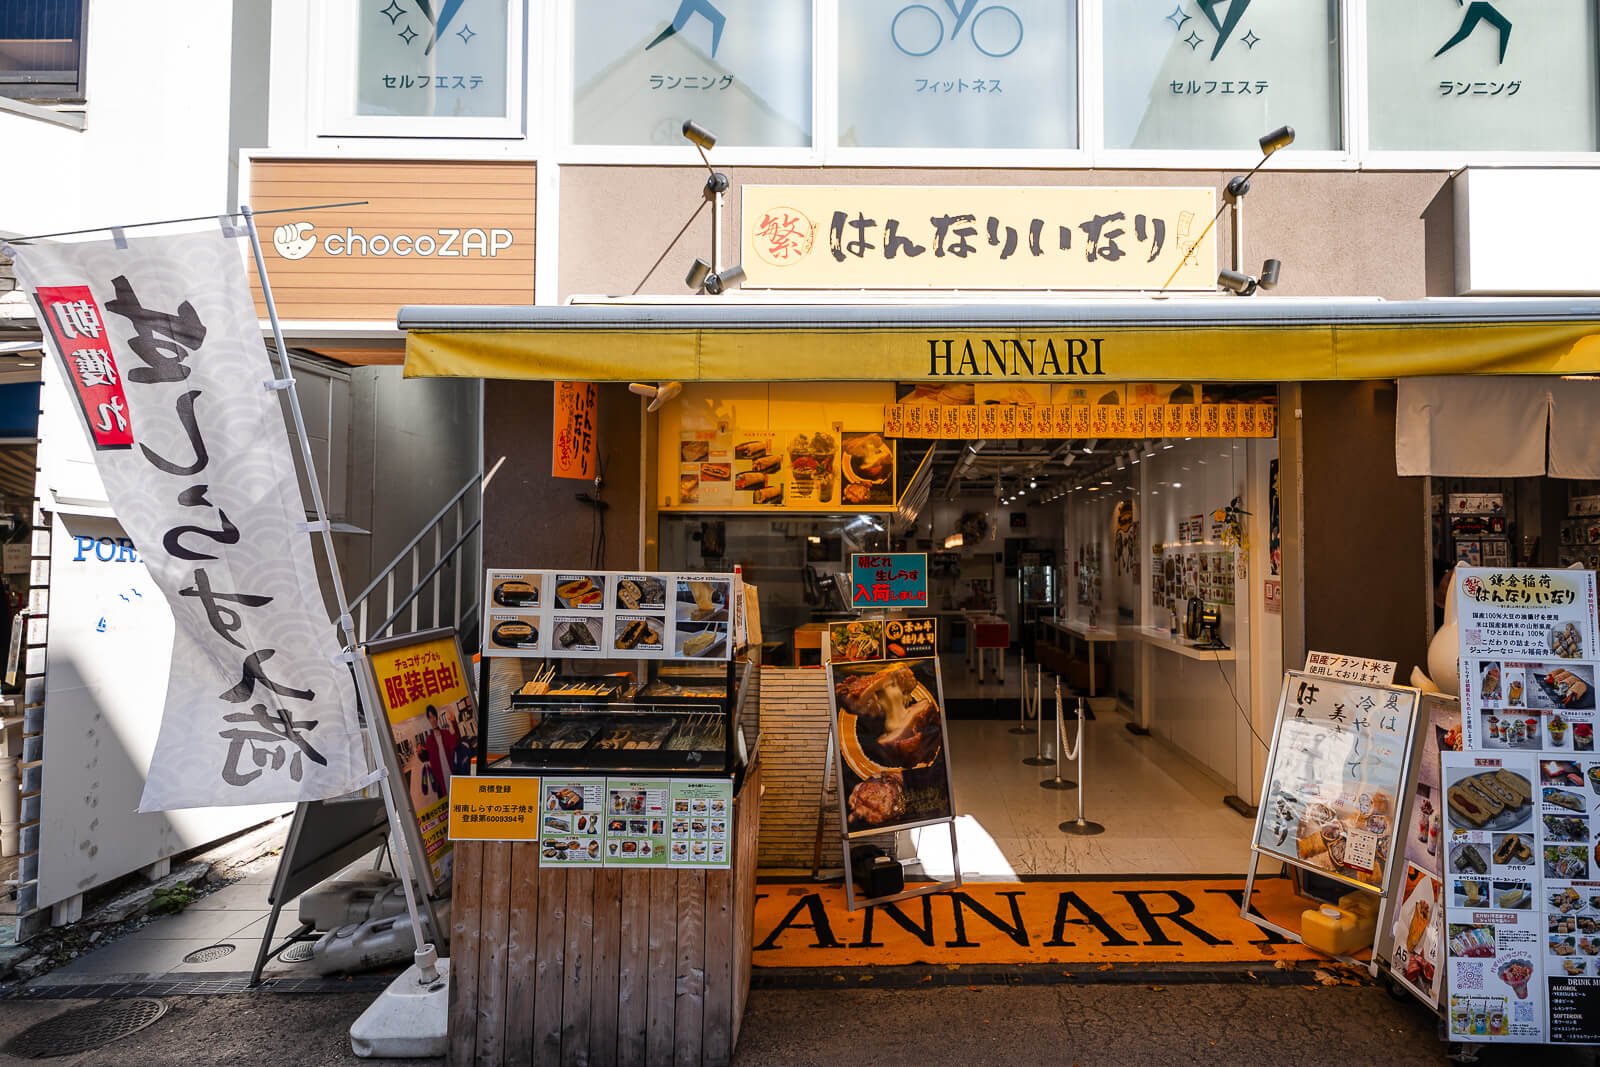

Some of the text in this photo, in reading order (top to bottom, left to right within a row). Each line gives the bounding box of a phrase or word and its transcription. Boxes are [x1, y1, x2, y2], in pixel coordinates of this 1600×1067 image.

[382, 74, 484, 91] セルフエステ
[649, 74, 734, 91] ランニング
[915, 78, 1003, 94] フィットネス
[1169, 79, 1269, 95] セルフエステ
[1439, 80, 1522, 97] ランニング
[323, 228, 514, 259] chocoZAP
[830, 211, 1166, 264] はんなりいなり
[927, 338, 1107, 376] HANNARI
[73, 535, 144, 562] POR
[875, 569, 920, 581] 生しらす
[1489, 574, 1551, 588] 鎌倉稲荷
[854, 583, 926, 602] 入荷しました
[1476, 588, 1575, 604] はんなりいなり
[1310, 653, 1391, 674] 国産ブランド米を
[1309, 665, 1381, 684] 使用しております。
[384, 661, 460, 709] 服装自由!
[1380, 691, 1401, 732] 夏は
[1347, 696, 1376, 778] 冷やして
[478, 785, 512, 793] 商標登録
[454, 804, 534, 813] 湘南しらすの玉子焼き
[462, 814, 525, 823] 登録第6009394号
[753, 888, 1303, 951] ANNARI
[1395, 945, 1408, 962] A5
[1568, 978, 1591, 986] DRINK
